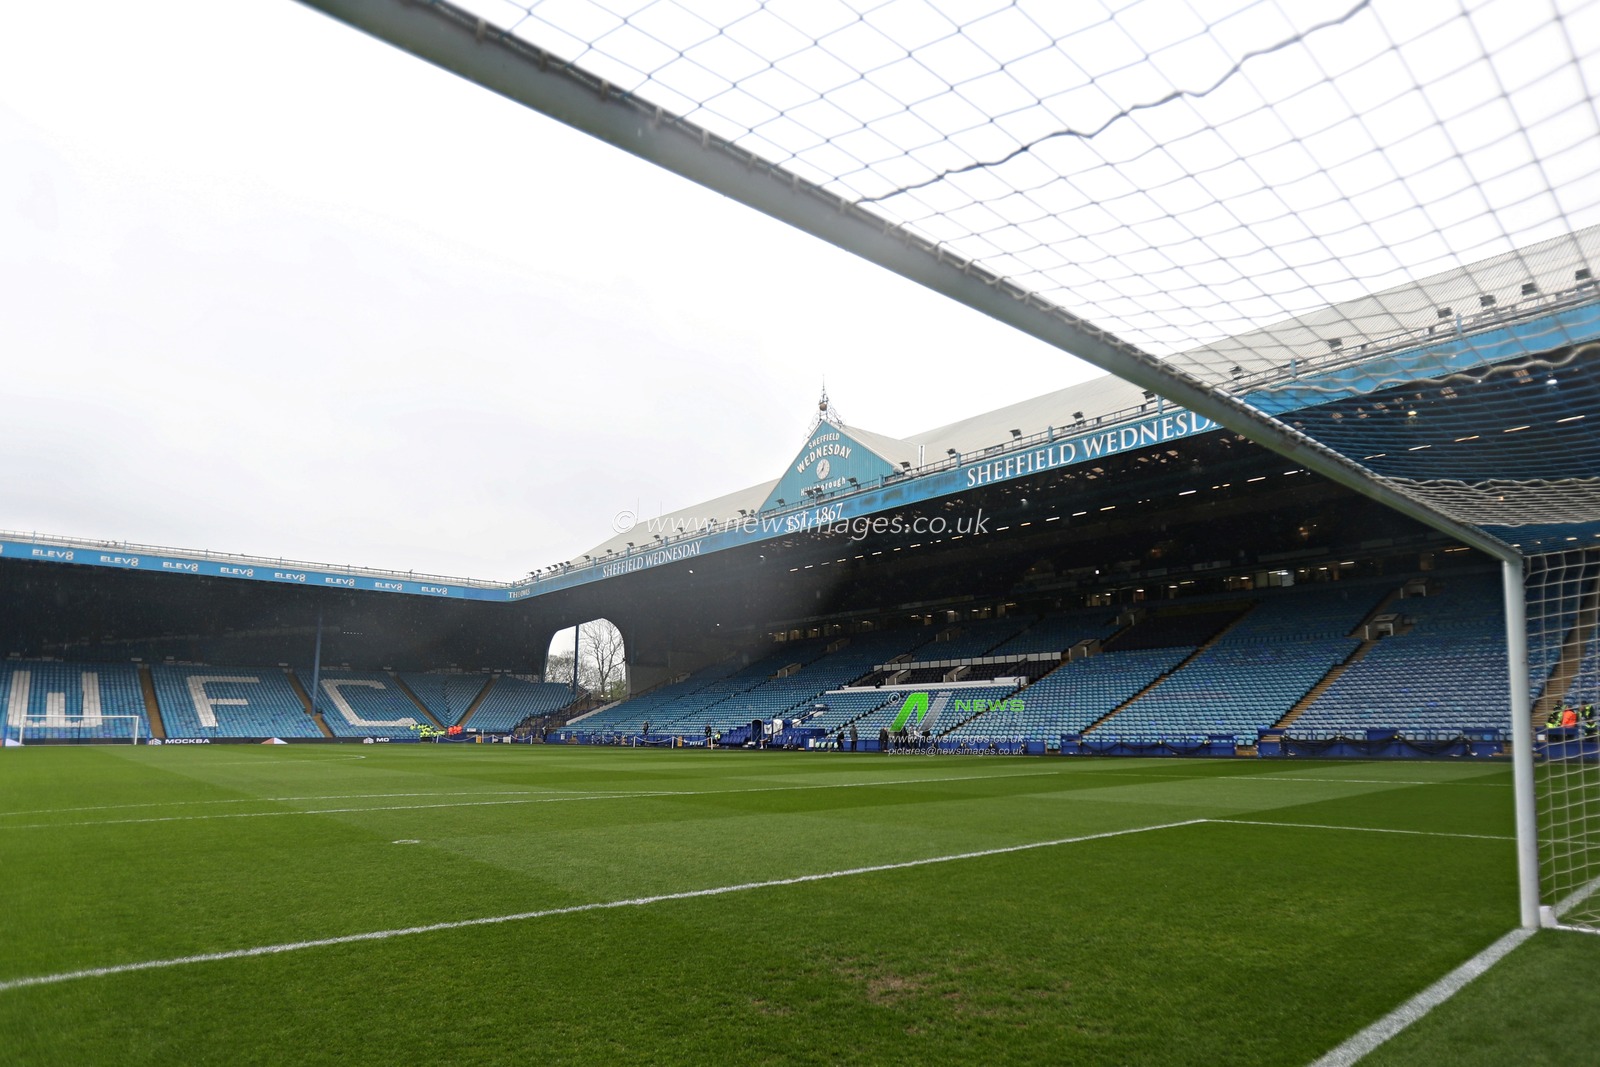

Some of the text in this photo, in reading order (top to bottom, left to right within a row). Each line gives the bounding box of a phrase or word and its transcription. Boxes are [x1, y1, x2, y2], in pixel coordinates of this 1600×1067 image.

[808, 433, 840, 450] SHEFFIELD
[967, 411, 1218, 487] SHEFFIELD WEDNESD
[796, 444, 852, 474] WEDNESDAY
[815, 503, 844, 524] 1867
[32, 549, 74, 561] ELEV8
[100, 555, 139, 567] ELEV8
[602, 541, 702, 578] SHEFFIELD WEDNESDAY
[162, 561, 198, 572] ELEV8
[220, 567, 254, 577] ELEV8
